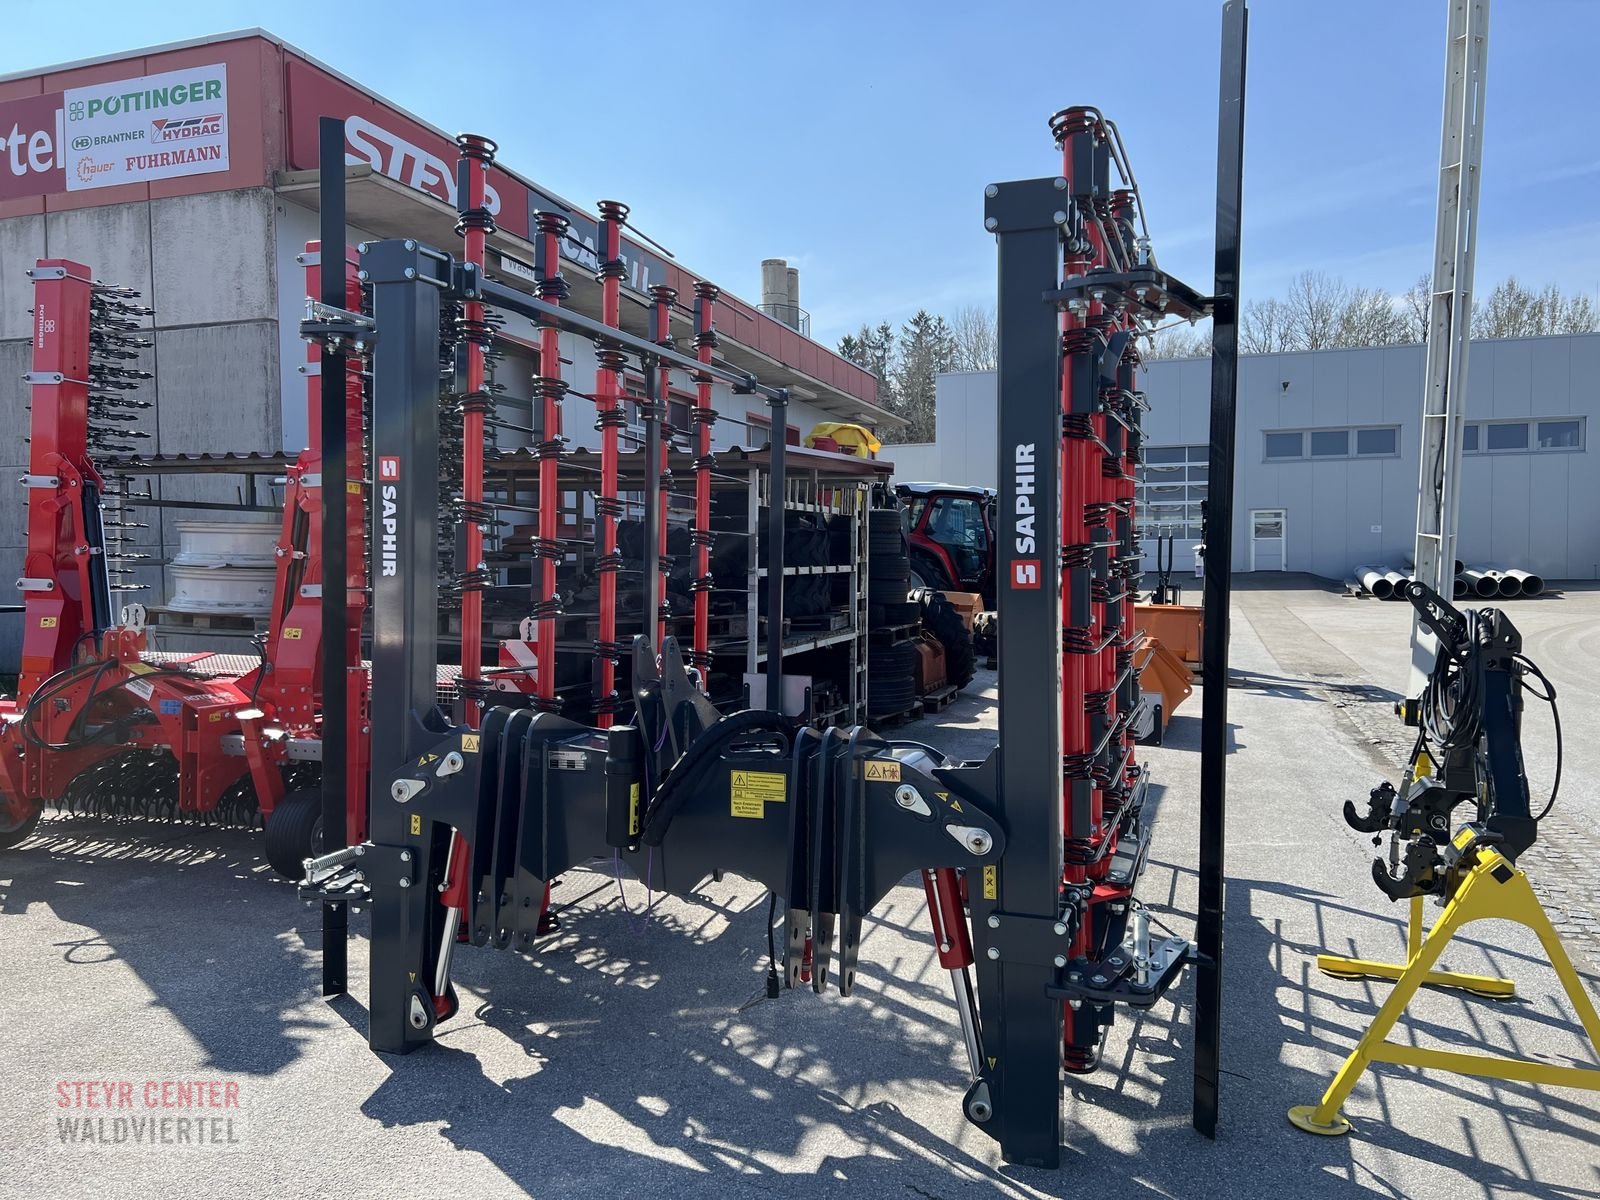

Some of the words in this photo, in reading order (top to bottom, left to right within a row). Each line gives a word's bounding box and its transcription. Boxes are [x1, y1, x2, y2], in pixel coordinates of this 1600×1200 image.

[87, 79, 222, 119] PÖTTINGER
[93, 130, 145, 146] BRANTNER
[163, 123, 221, 140] HYDRAC
[83, 162, 116, 175] hauer
[125, 145, 222, 172] FUHRMANN
[1015, 442, 1036, 554] SAPHIR
[382, 485, 397, 577] SAPHIR
